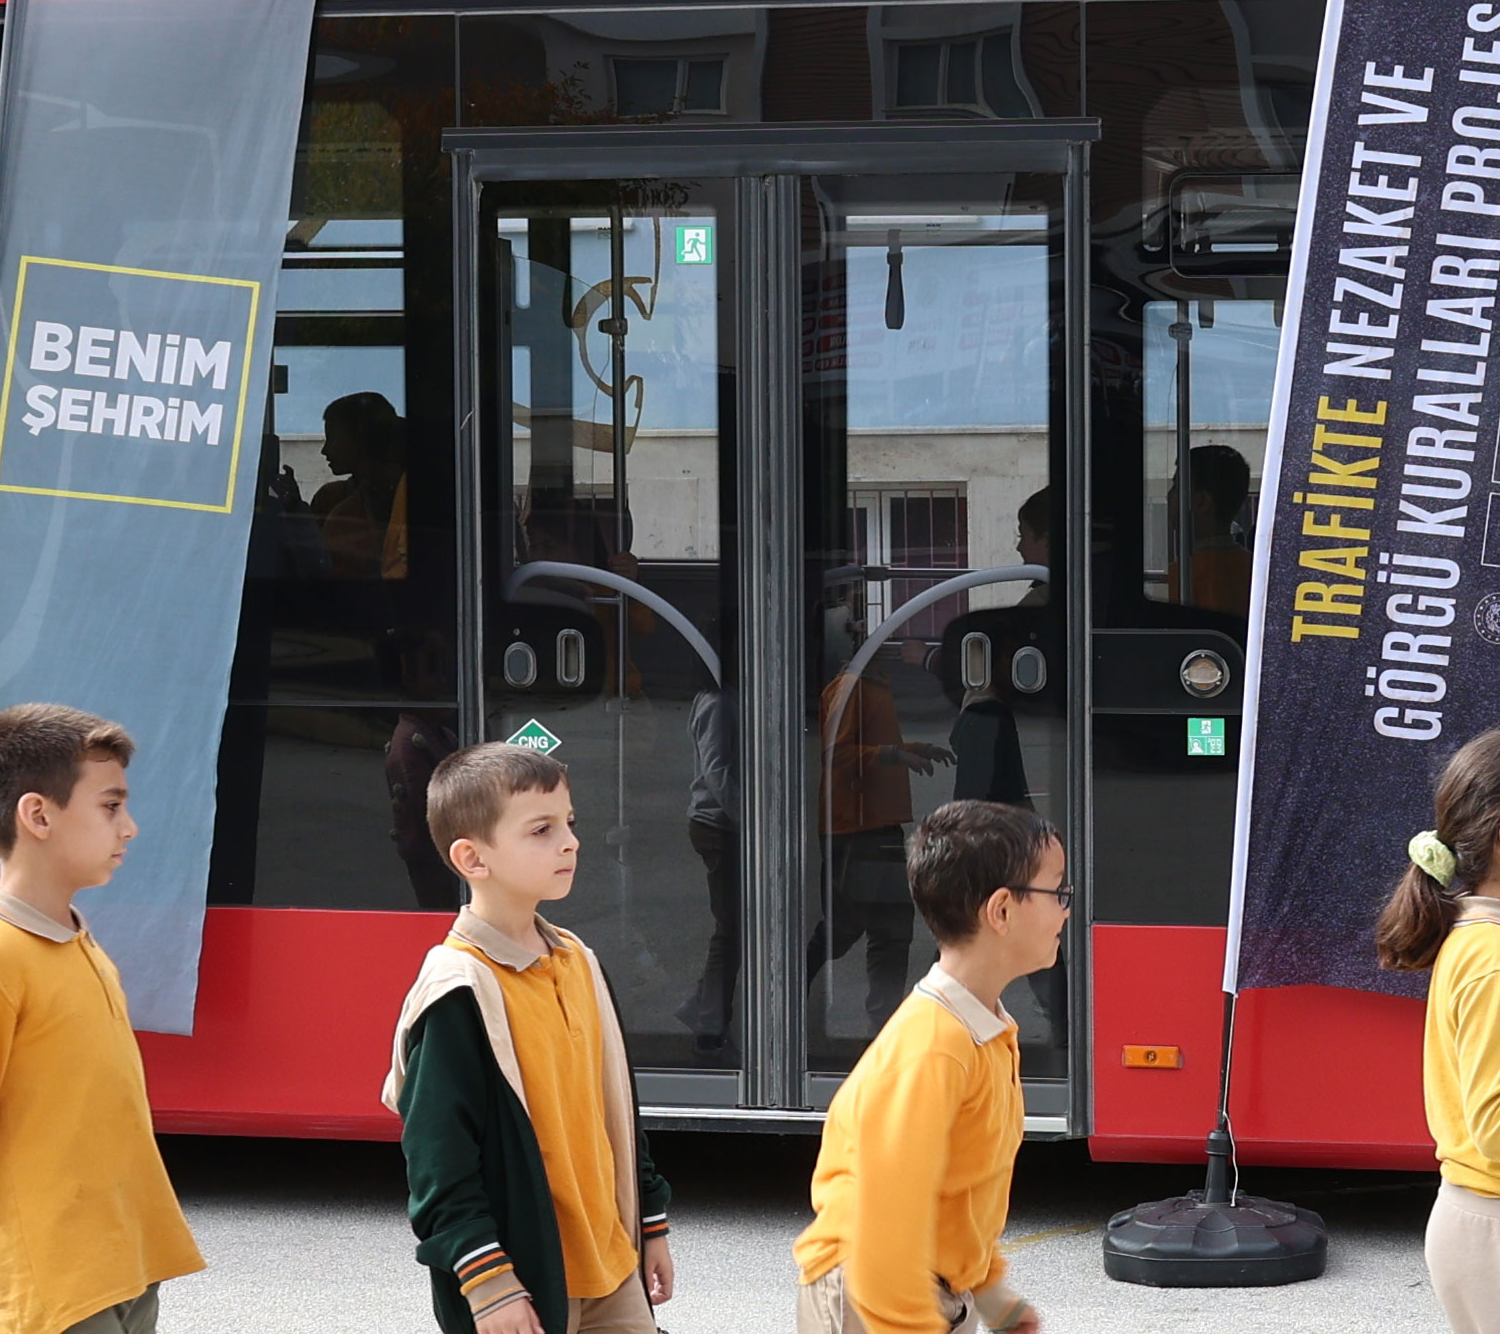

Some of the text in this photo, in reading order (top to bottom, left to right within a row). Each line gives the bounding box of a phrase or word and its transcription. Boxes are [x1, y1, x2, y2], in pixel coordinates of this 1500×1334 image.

[29, 320, 232, 392] BENİM
[1289, 61, 1435, 642] TRAFİKTE NEZAKET VE
[22, 384, 224, 447] ŞEHRİM
[1364, 542, 1461, 742] GÖRGÜ
[518, 735, 549, 749] CNG
